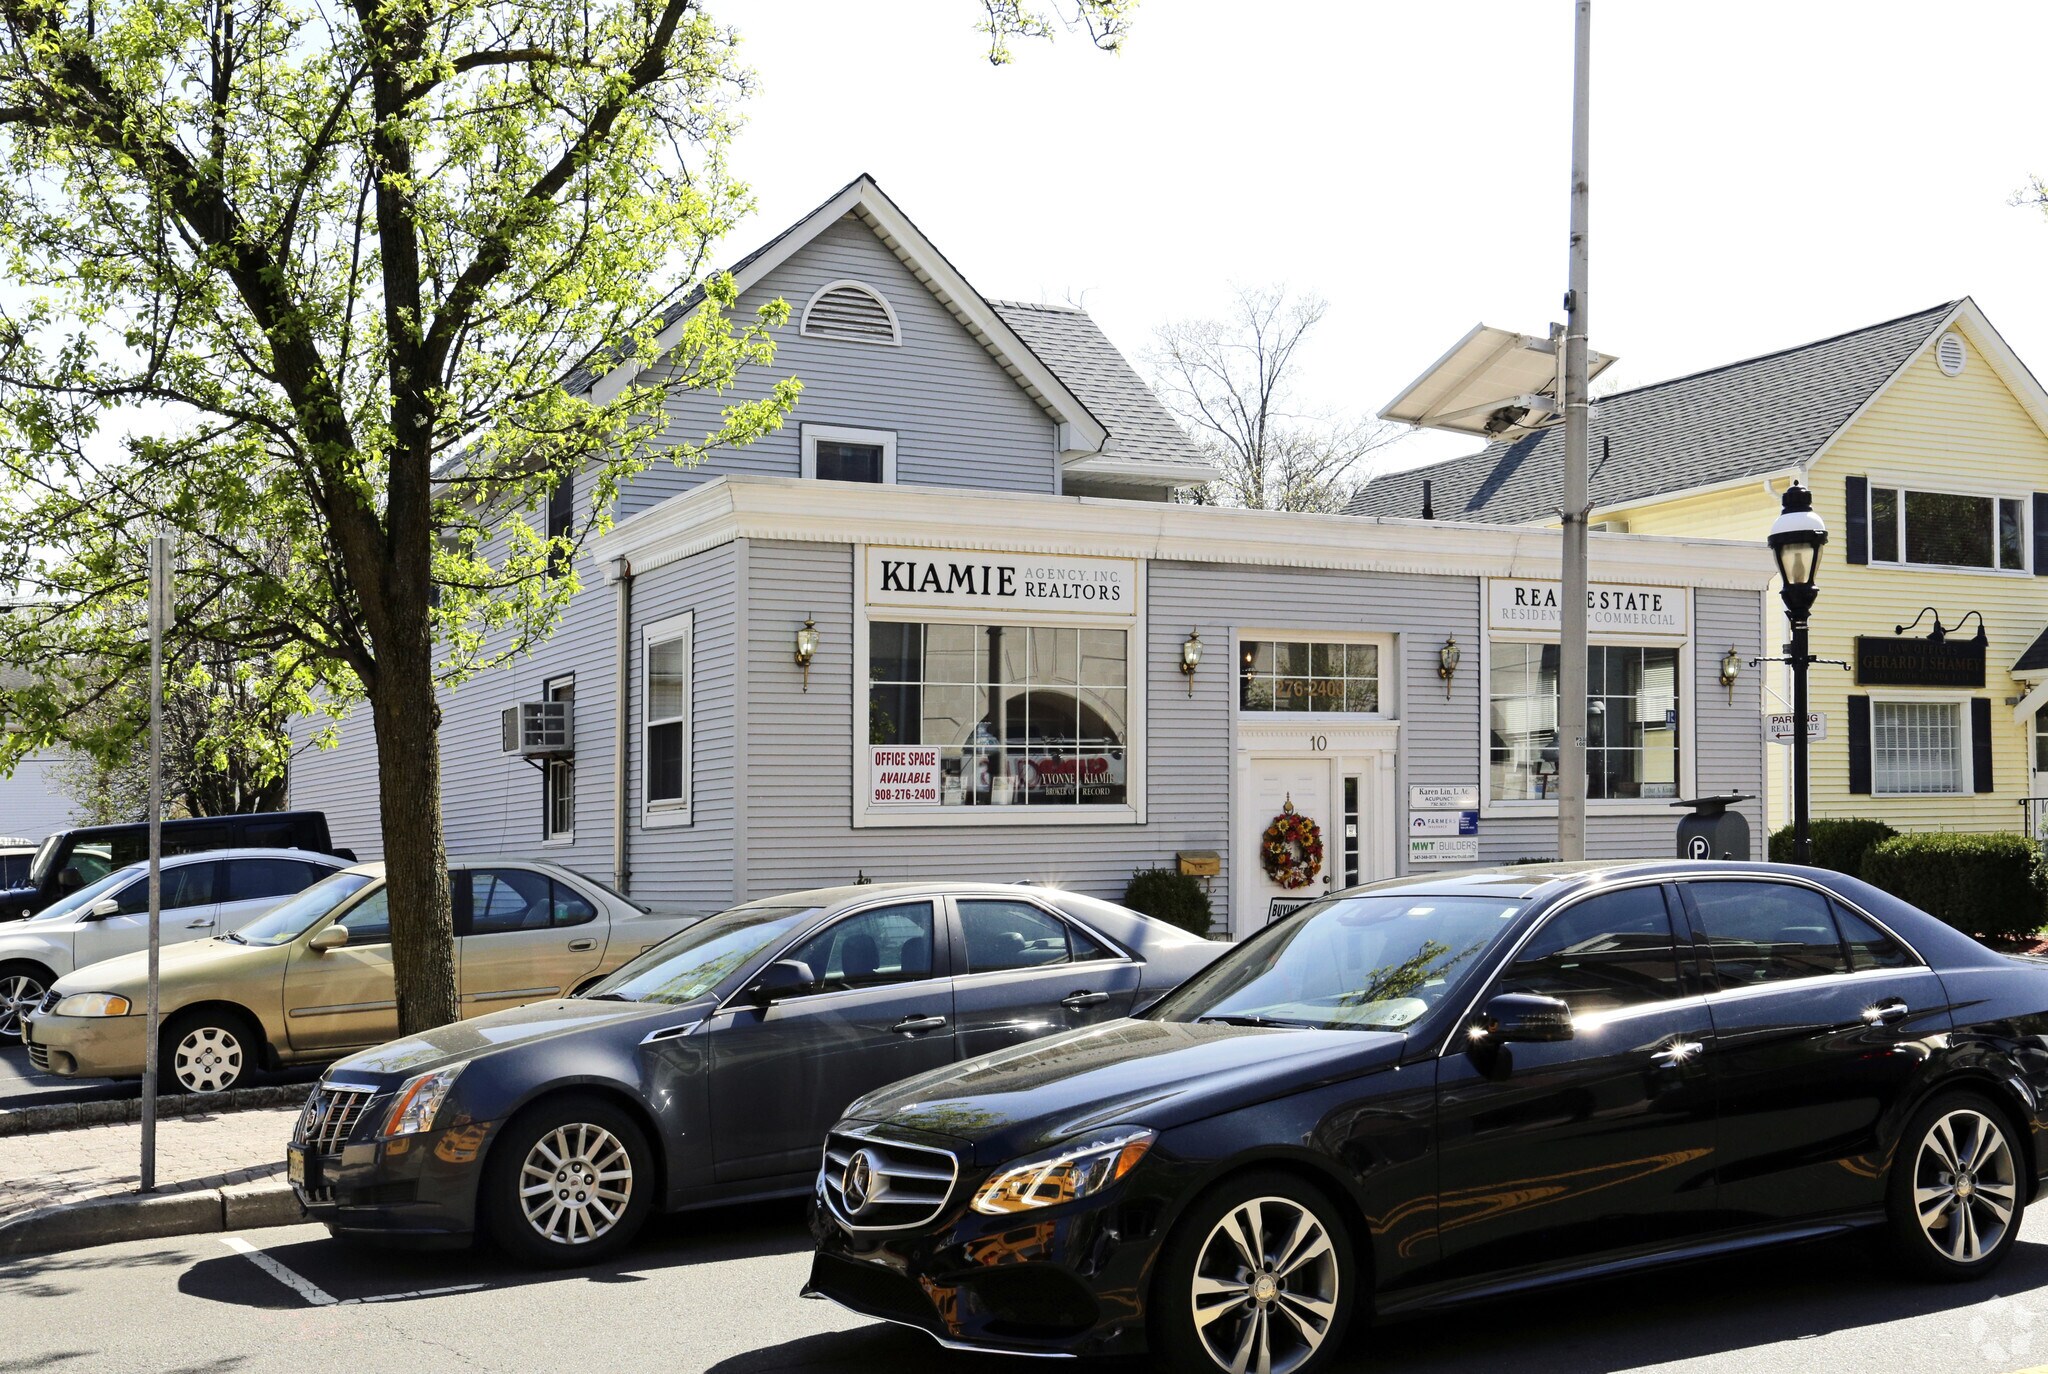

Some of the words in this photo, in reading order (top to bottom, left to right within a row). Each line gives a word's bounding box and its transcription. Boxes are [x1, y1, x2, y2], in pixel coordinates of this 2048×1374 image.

[881, 560, 1017, 597] KIAMIE
[1093, 570, 1122, 583] INC.
[1025, 581, 1121, 601] REALTORS
[1514, 587, 1558, 607] REA
[1588, 591, 1663, 612] ESTATE
[1502, 607, 1562, 621] RESIDENT
[1595, 611, 1676, 626] COMMERCIAL
[1888, 643, 1908, 654] LAW
[1912, 644, 1958, 656] OFFICES
[1862, 655, 1917, 671] GERARD
[1929, 657, 1983, 673] SHAMEY
[1772, 714, 1819, 724] PARG
[1771, 724, 1791, 733] REAL
[1309, 735, 1328, 752] 10
[875, 752, 906, 766] OFFICE
[908, 752, 936, 766] SPACE
[879, 772, 932, 784] AVAILABLE
[1041, 772, 1076, 785] YVONNE
[1083, 772, 1115, 785] KIAMIE
[875, 788, 936, 800] 908-276-2400
[1045, 786, 1067, 796] BROKER
[1082, 787, 1111, 796] RECORD
[1412, 841, 1436, 851] MWT
[1439, 840, 1477, 851] BUILDERS
